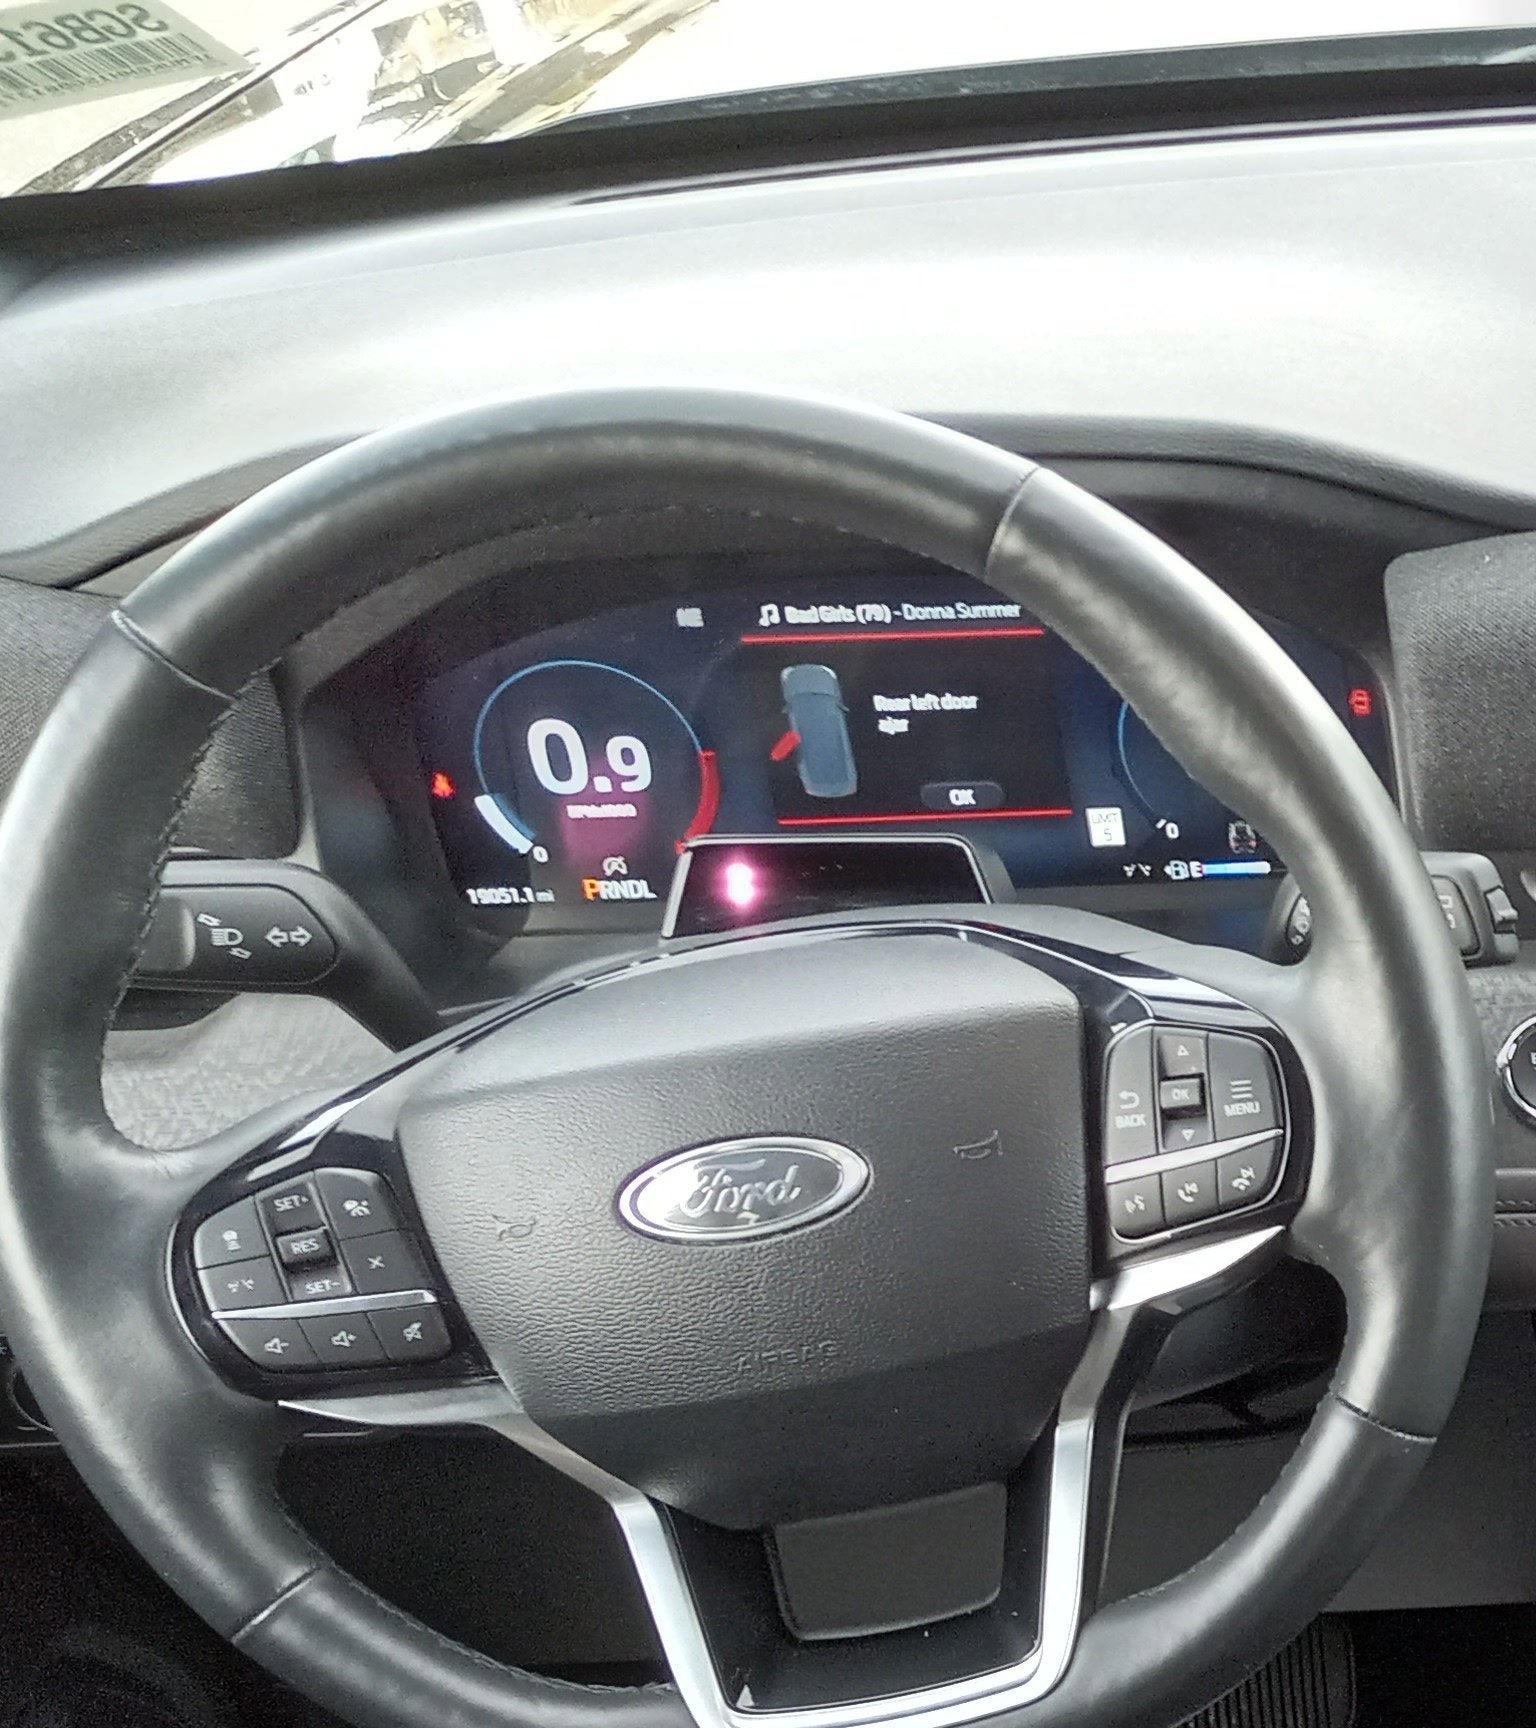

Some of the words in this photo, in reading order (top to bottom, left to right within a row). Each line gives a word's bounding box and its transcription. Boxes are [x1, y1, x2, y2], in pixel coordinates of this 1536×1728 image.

[901, 604, 956, 622] Donna
[955, 601, 1022, 620] Summer
[527, 718, 652, 796] 0.9
[949, 788, 976, 806] OK
[1189, 861, 1204, 877] E
[1172, 1088, 1190, 1100] OK
[1224, 1101, 1261, 1117] MENU
[1115, 1114, 1147, 1129] BACK
[680, 1158, 801, 1218] Ford
[273, 1195, 309, 1212] SET+
[290, 1238, 320, 1254] RES
